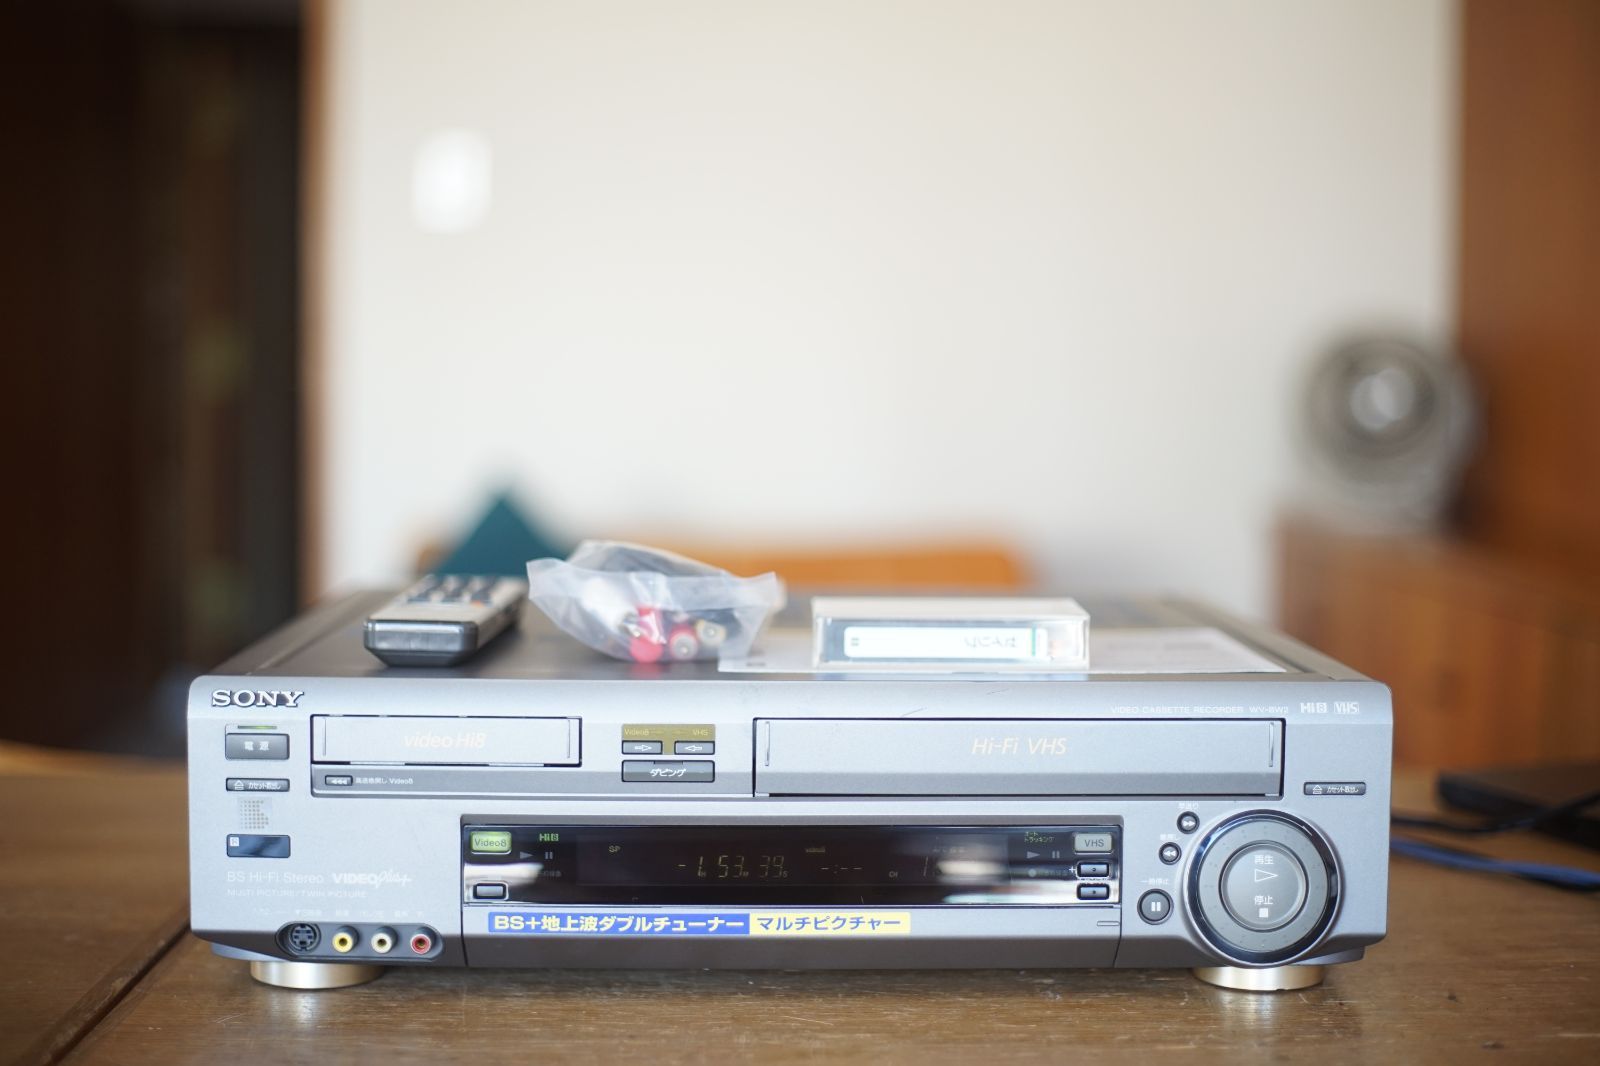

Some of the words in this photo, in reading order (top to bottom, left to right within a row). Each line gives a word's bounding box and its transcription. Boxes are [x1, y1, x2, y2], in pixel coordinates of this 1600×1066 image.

[211, 690, 304, 707] SONY
[1110, 706, 1139, 714] VIDEO
[1142, 706, 1191, 714] CASSETTE
[1193, 706, 1244, 714] RECORDER
[1333, 702, 1360, 714] VHS
[403, 732, 454, 749] video
[454, 731, 488, 749] Hi8
[971, 738, 1019, 755] Hi-Fi
[1028, 738, 1067, 755] VHS
[650, 767, 687, 777] ダビング
[475, 838, 507, 848] Video8
[1084, 838, 1105, 848] VHS
[1254, 855, 1274, 865] 再生
[227, 871, 246, 882] BS
[249, 871, 281, 883] Hi-Fi
[283, 871, 324, 884] Stereo
[332, 873, 377, 885] VIDEO
[1254, 895, 1274, 906] 停止
[494, 914, 745, 933] BS+地上波ダブルチューナー
[756, 915, 902, 932] マルチピクチャー
